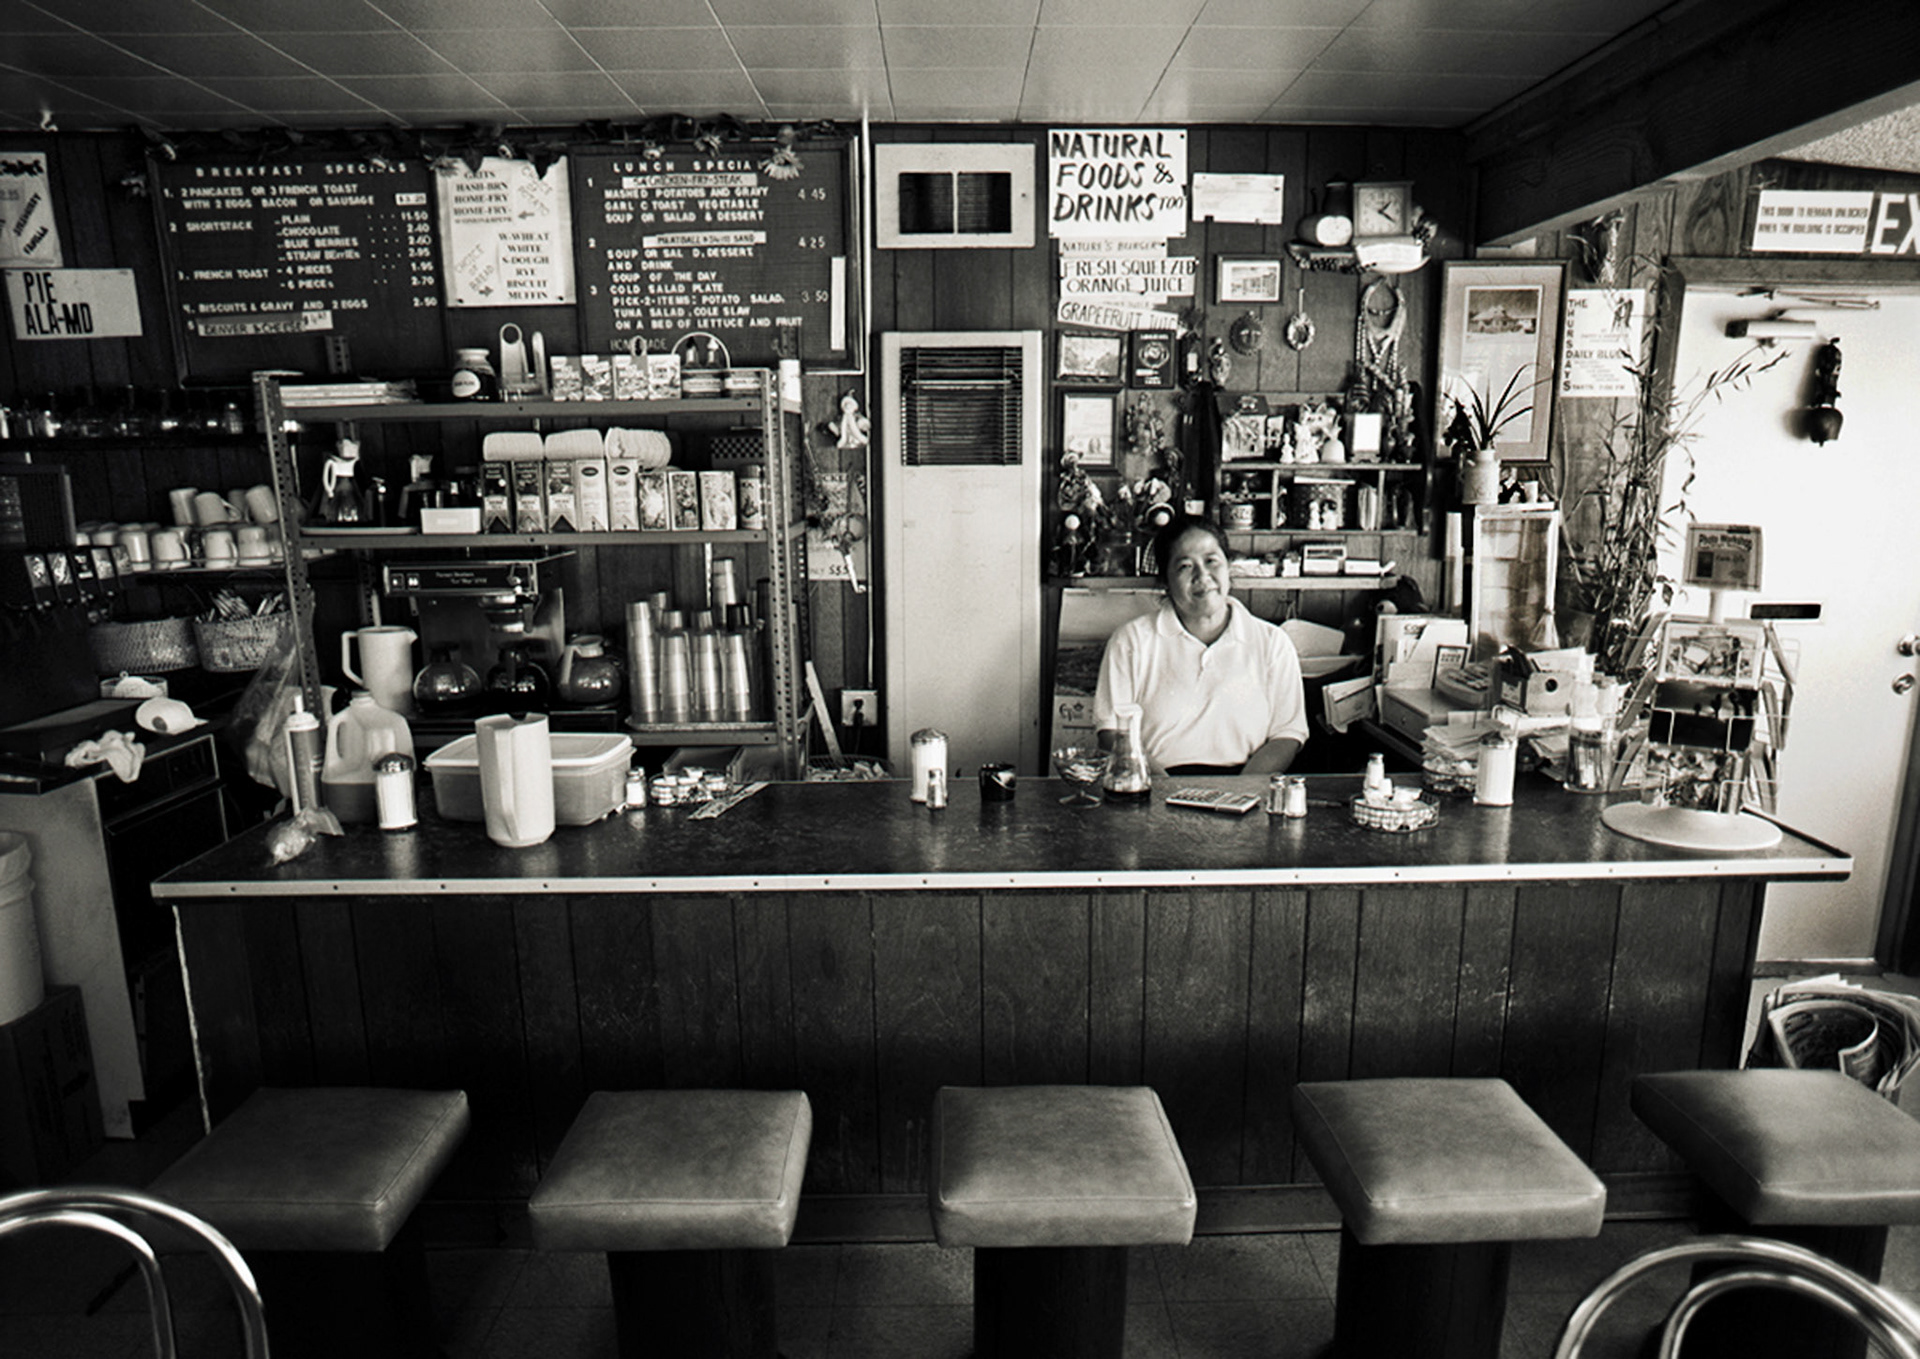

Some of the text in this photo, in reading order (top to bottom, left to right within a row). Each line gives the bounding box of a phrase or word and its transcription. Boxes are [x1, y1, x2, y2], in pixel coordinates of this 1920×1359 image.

[1051, 132, 1172, 159] NATURAL
[195, 165, 303, 178] BREAKFAST
[613, 160, 675, 174] LUNCH
[1056, 162, 1174, 190] FOODS &
[189, 187, 244, 197] PANCAKES
[251, 186, 266, 196] OR
[279, 185, 318, 196] FRENCH
[323, 184, 358, 195] TOAST
[604, 189, 648, 199] MASHED
[655, 188, 706, 198] POTATOES
[710, 187, 731, 198] AND
[734, 186, 769, 197] GRAVY
[183, 199, 211, 210] WITH
[215, 199, 222, 210] 2
[225, 199, 253, 209] EGGS
[261, 198, 298, 208] BACON
[309, 197, 324, 207] OR
[326, 195, 374, 207] SAUSAGE
[604, 200, 635, 211] GARL
[652, 200, 685, 211] TOAST
[697, 198, 760, 210] VEGETABLE
[1053, 192, 1184, 222] DRINKS TOO
[605, 213, 634, 224] SOUP
[641, 213, 655, 223] OR
[663, 211, 697, 222] SALAD
[716, 210, 765, 222] DESSERT
[186, 221, 253, 233] SHORTSTACK
[314, 236, 359, 248] BERRIES
[507, 244, 542, 253] WHITE
[606, 249, 639, 260] SOUP
[644, 249, 658, 259] OR
[516, 268, 535, 276] RYE
[607, 260, 673, 271] AND DRINK
[1063, 258, 1196, 278] FRESH SQUEEZED
[193, 269, 233, 280] FRENCH
[236, 268, 269, 279] TOAST
[612, 270, 717, 283] SOUP OF THE DAY
[23, 272, 57, 303] PIE
[507, 279, 548, 288] BISCUIT
[609, 284, 641, 295] COLD
[647, 283, 686, 294] SALAD
[692, 282, 724, 293] PLATE
[1066, 277, 1184, 294] ORANGE JUICE
[508, 291, 548, 300] MUFFIN
[701, 294, 741, 305] POTATO
[198, 302, 247, 313] BISCUITS
[260, 301, 295, 312] GRAVY
[302, 300, 325, 310] AND
[340, 299, 369, 310] EGGS
[613, 308, 643, 318] TUNA
[693, 307, 719, 317] COLE
[722, 306, 751, 316] SLAW
[1060, 301, 1143, 330] GRAPEFRUIT
[614, 316, 803, 331] ON A BED OF LETTUCE AND FRUIT
